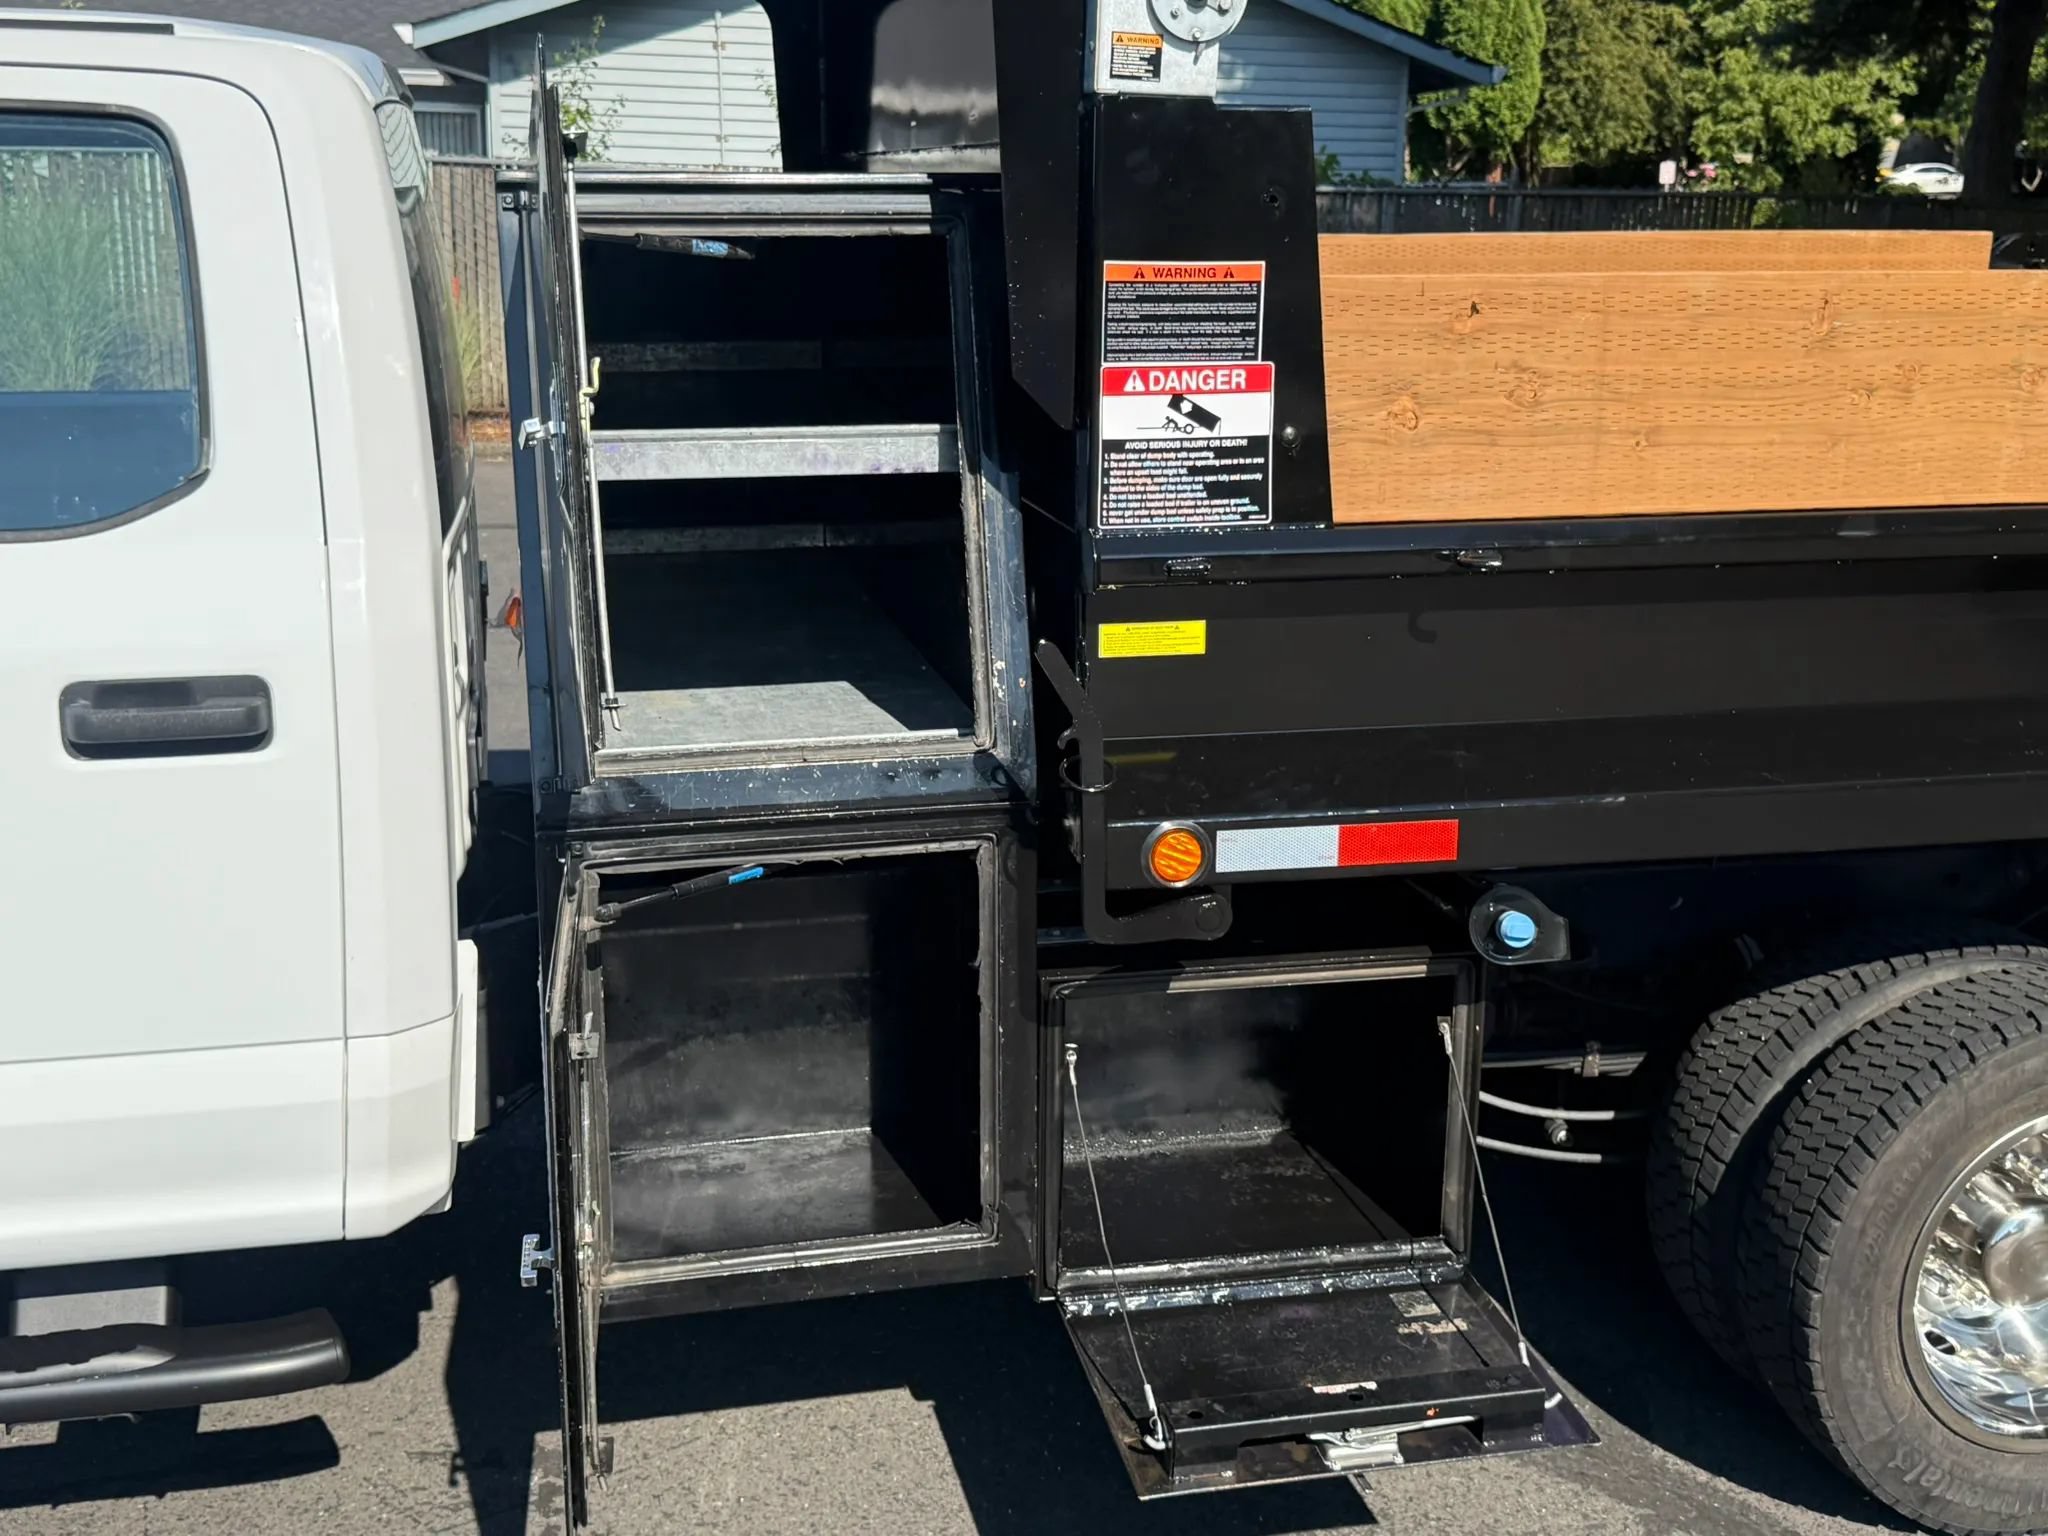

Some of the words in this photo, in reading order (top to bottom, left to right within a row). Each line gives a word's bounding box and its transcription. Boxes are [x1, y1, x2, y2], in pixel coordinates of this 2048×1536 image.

[1127, 36, 1160, 44] WARNING
[1153, 268, 1216, 278] WARNING
[1149, 369, 1246, 391] DANGER
[1149, 441, 1180, 449] SERIOUS
